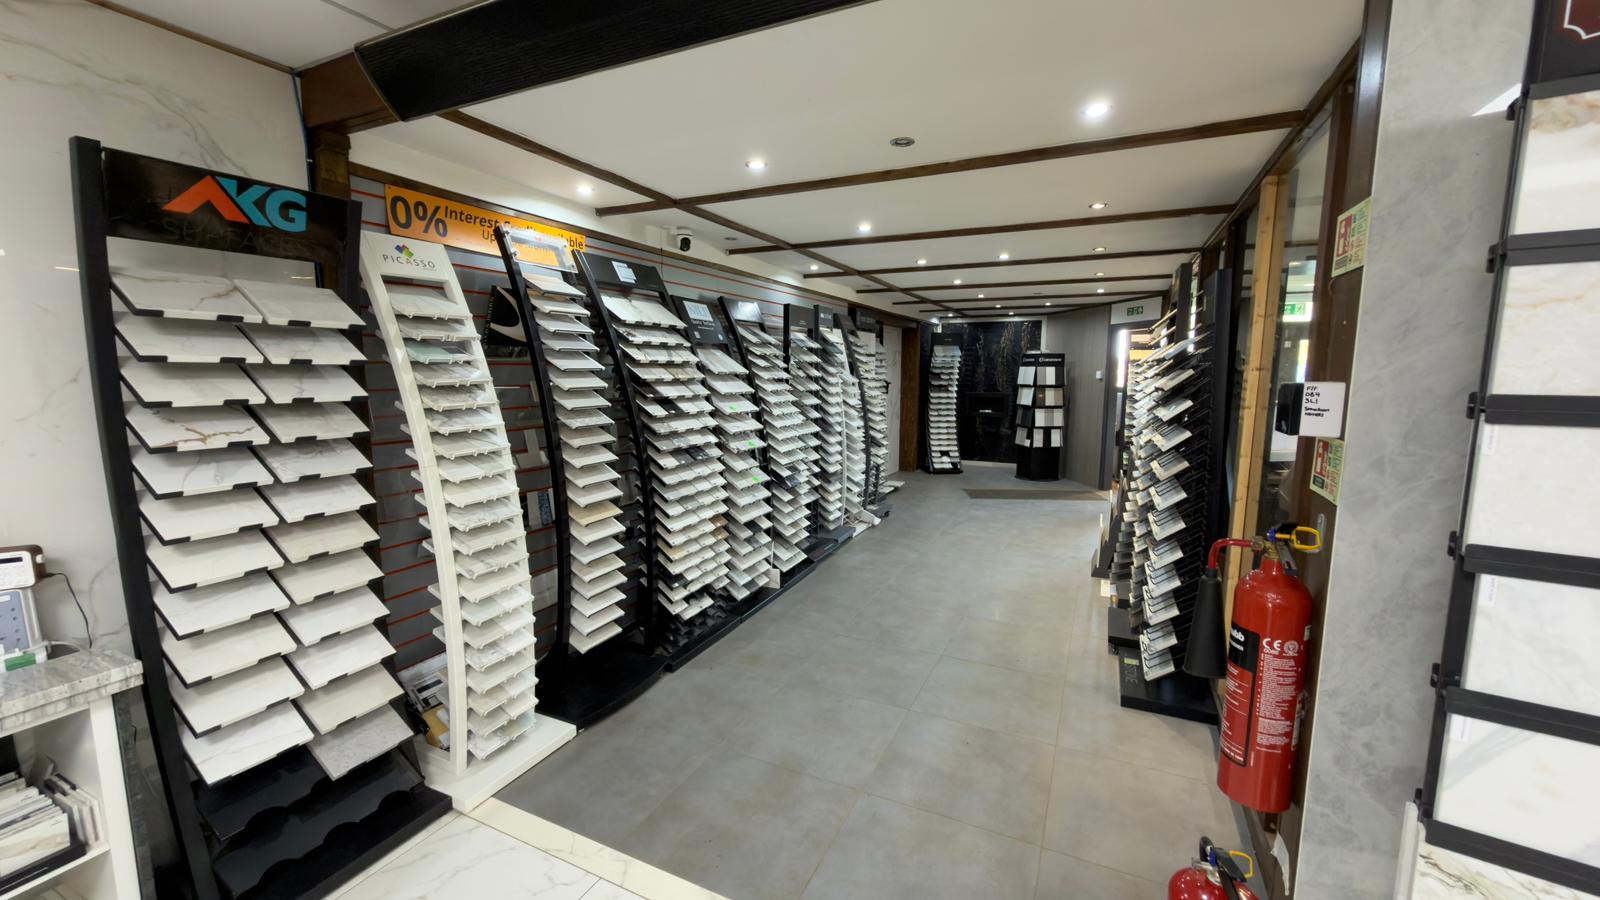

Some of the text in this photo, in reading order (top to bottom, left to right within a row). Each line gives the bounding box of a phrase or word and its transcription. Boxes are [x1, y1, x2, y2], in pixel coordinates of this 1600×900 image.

[390, 195, 448, 238] 0%
[444, 205, 500, 229] Interest
[383, 253, 436, 270] PICASSO
